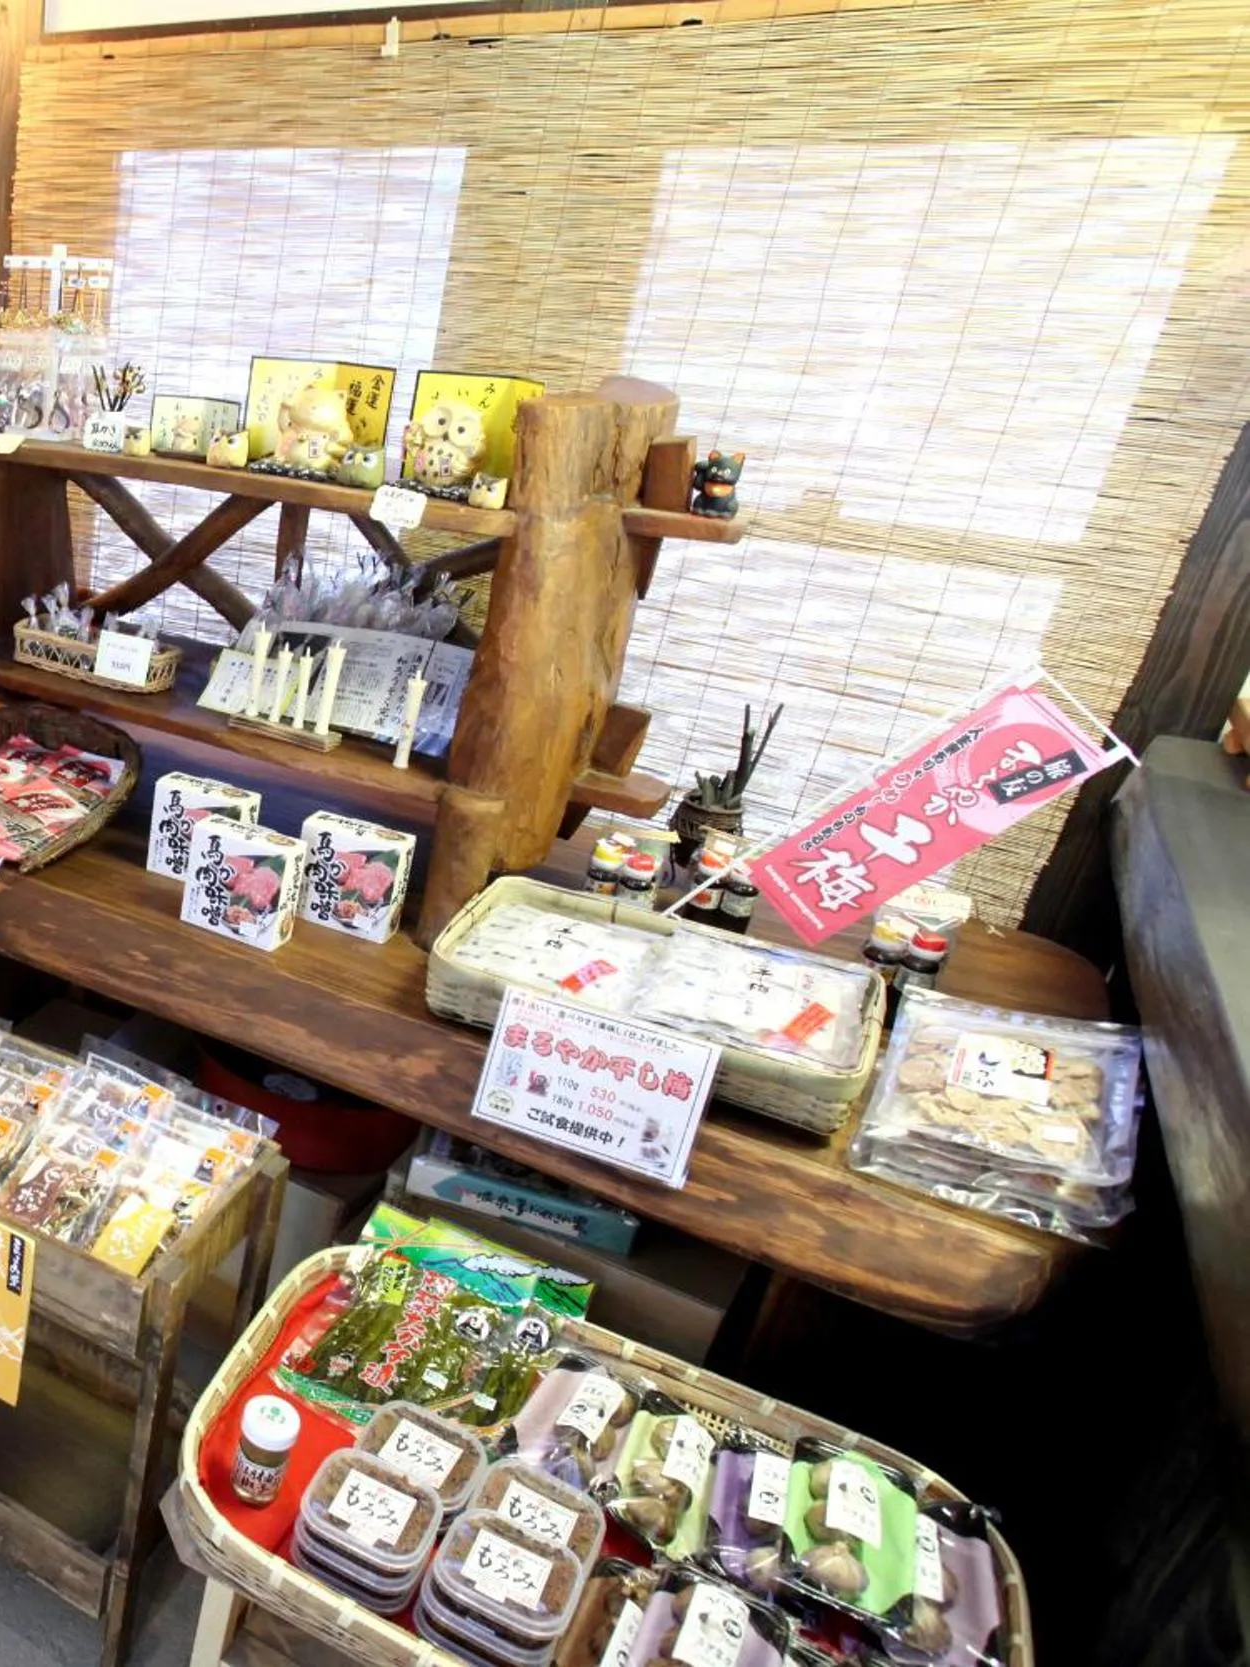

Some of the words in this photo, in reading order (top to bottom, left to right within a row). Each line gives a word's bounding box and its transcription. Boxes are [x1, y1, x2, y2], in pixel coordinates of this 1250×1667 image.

[503, 1023, 694, 1100] まろやか干し梅
[589, 1085, 617, 1103] 530
[395, 1431, 444, 1474] もろみ
[347, 1483, 399, 1527] もろみ
[509, 1495, 562, 1540] もろみ
[478, 1544, 537, 1590] もろみ
